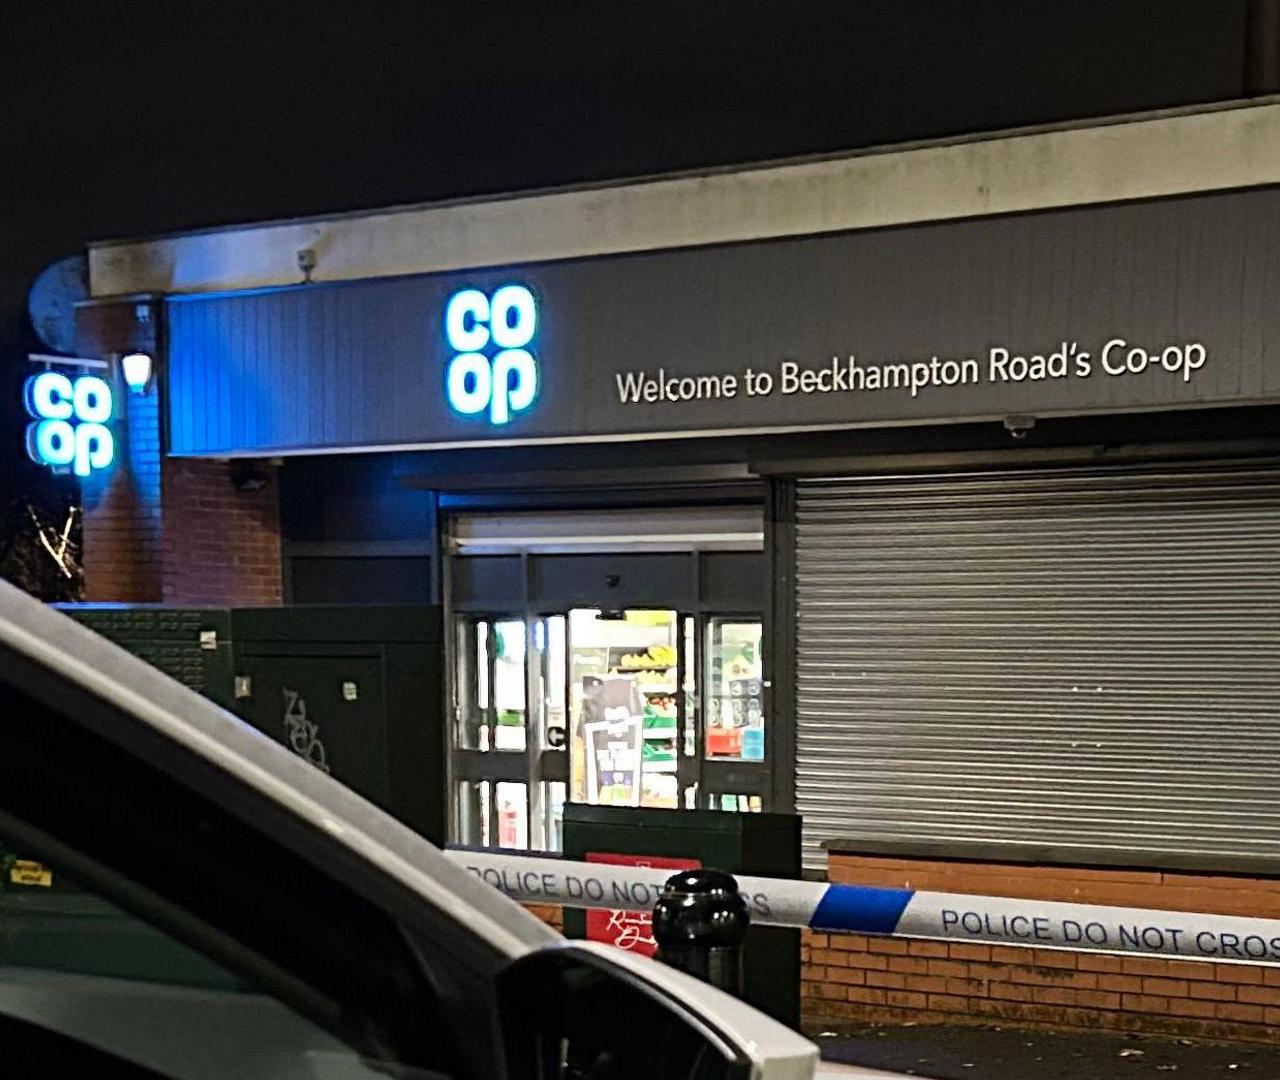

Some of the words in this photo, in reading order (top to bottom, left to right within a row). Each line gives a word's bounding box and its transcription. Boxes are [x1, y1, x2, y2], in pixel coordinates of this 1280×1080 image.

[616, 368, 738, 403] Welcome
[744, 368, 773, 396] to
[781, 356, 978, 397] Beckhampton
[989, 342, 1092, 382] Road's
[1101, 339, 1206, 382] Co-op
[466, 866, 557, 894] OLICE
[565, 875, 604, 901] DO
[941, 909, 1050, 941] POLICE
[1062, 919, 1108, 945] DO
[1120, 925, 1184, 953] NOT
